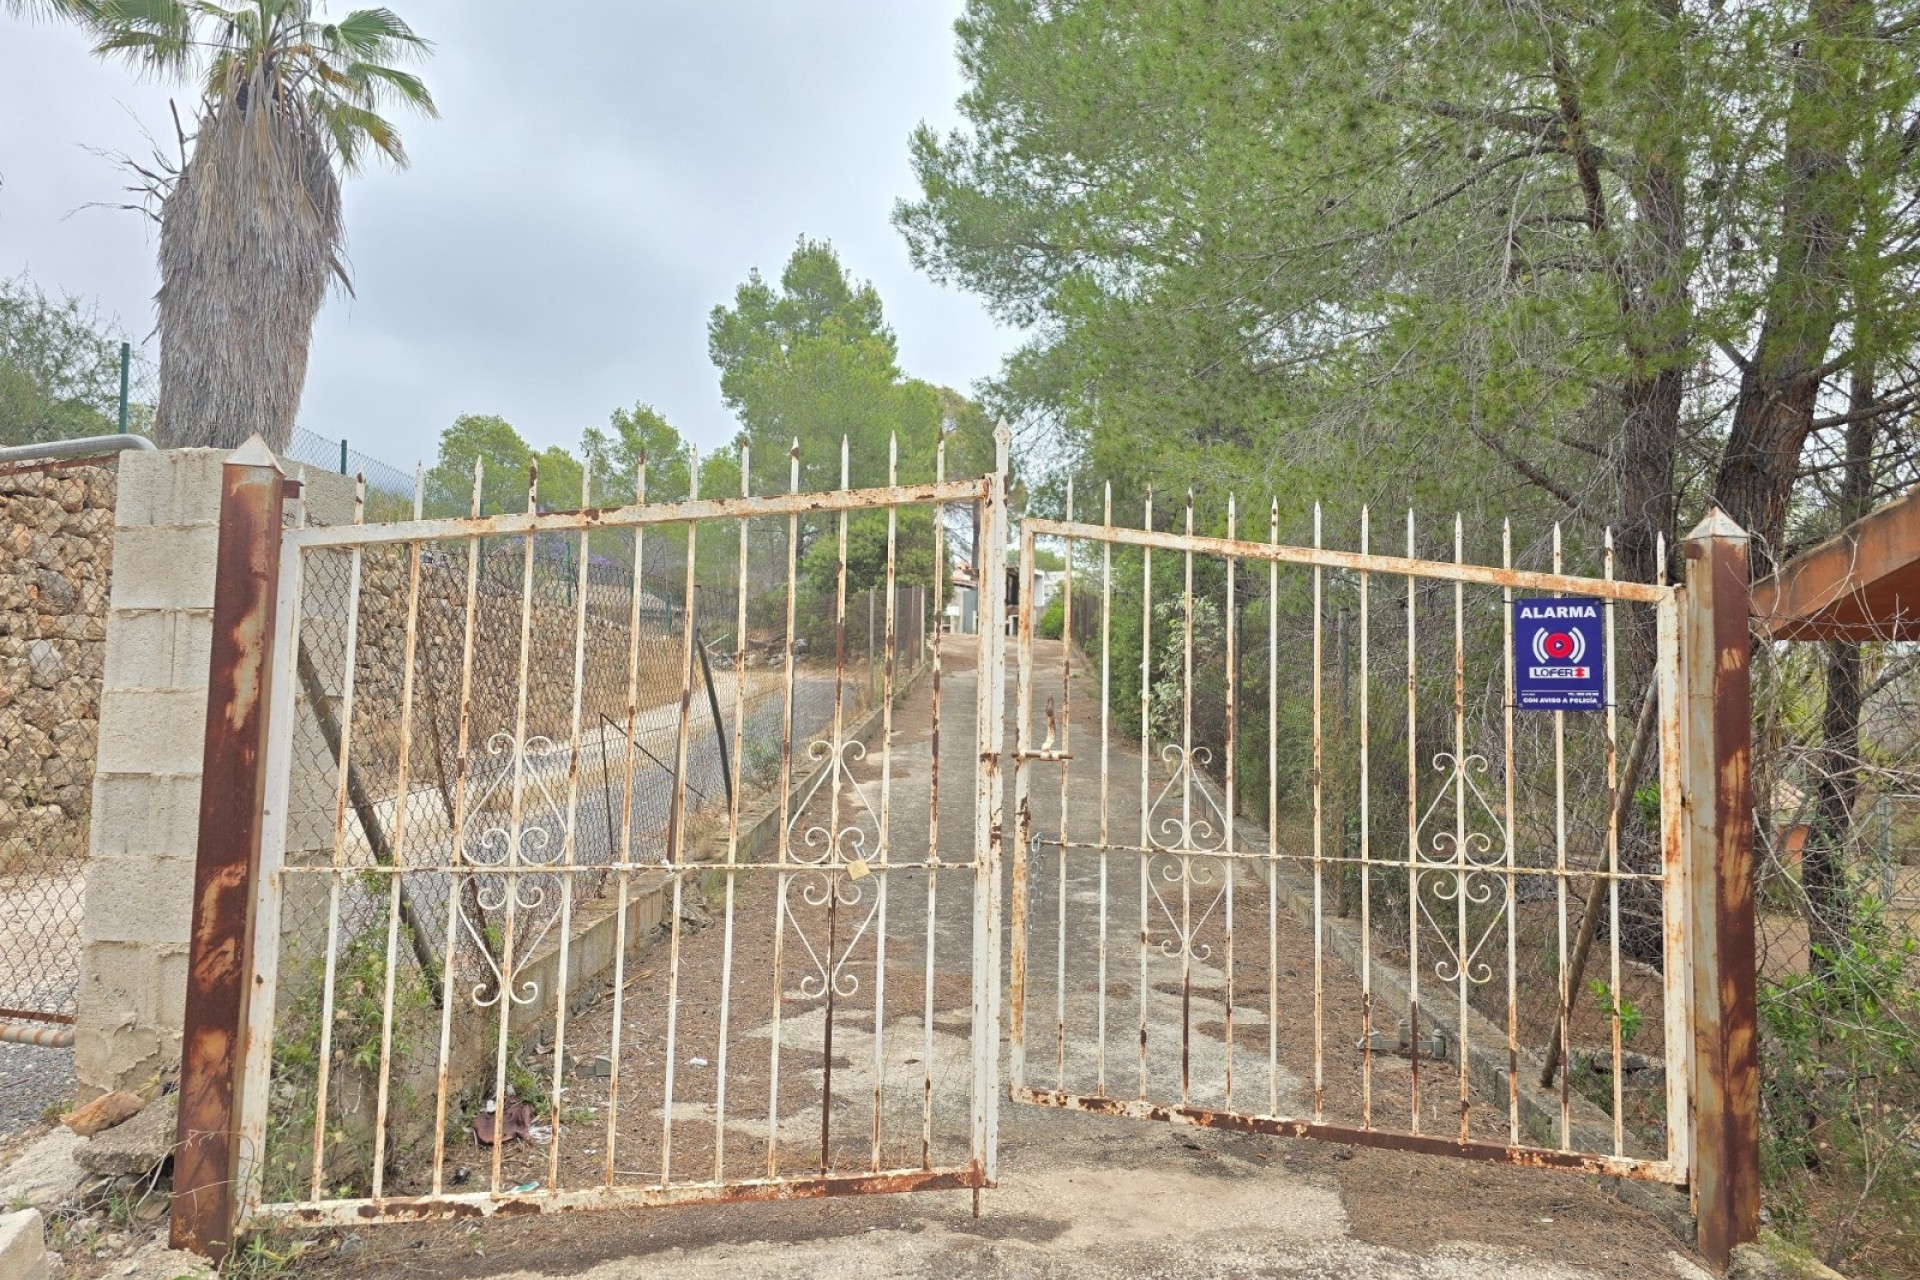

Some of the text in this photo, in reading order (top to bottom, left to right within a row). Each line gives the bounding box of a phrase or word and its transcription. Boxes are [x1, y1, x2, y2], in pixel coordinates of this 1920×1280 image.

[1520, 606, 1597, 619] ALARMA
[1533, 668, 1573, 677] LOFER
[1569, 696, 1597, 704] POLICÍA
